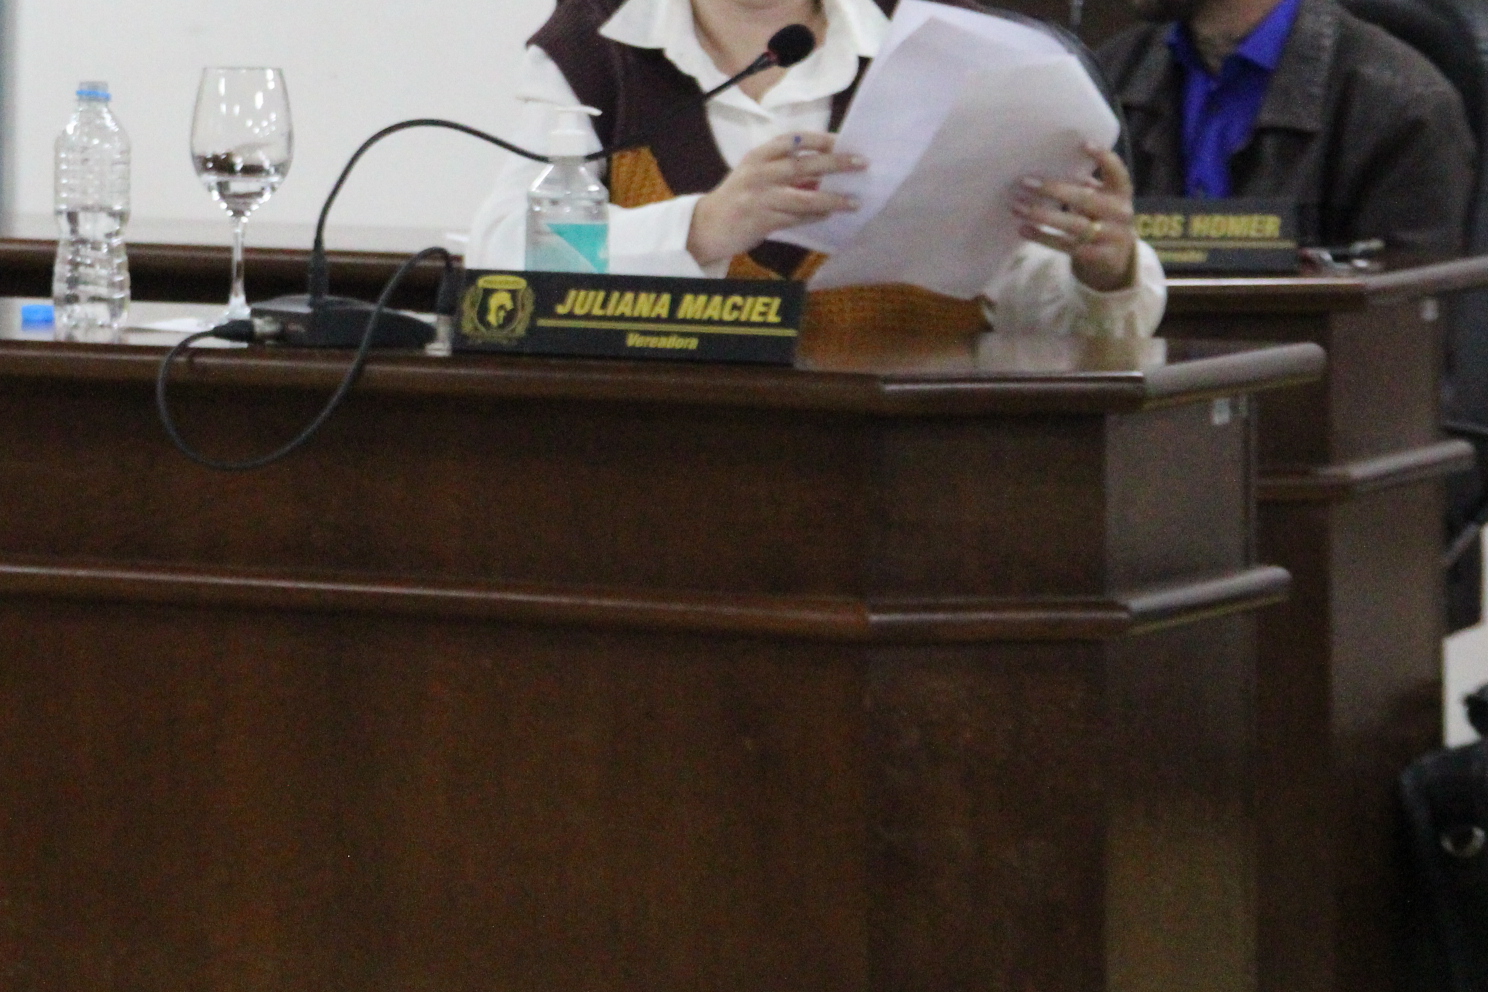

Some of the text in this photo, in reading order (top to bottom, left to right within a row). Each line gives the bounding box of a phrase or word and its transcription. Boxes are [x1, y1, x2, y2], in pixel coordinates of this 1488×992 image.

[1136, 214, 1184, 237] COS
[555, 289, 782, 323] JULIANA MACIEL
[626, 332, 699, 350] Vereadora
